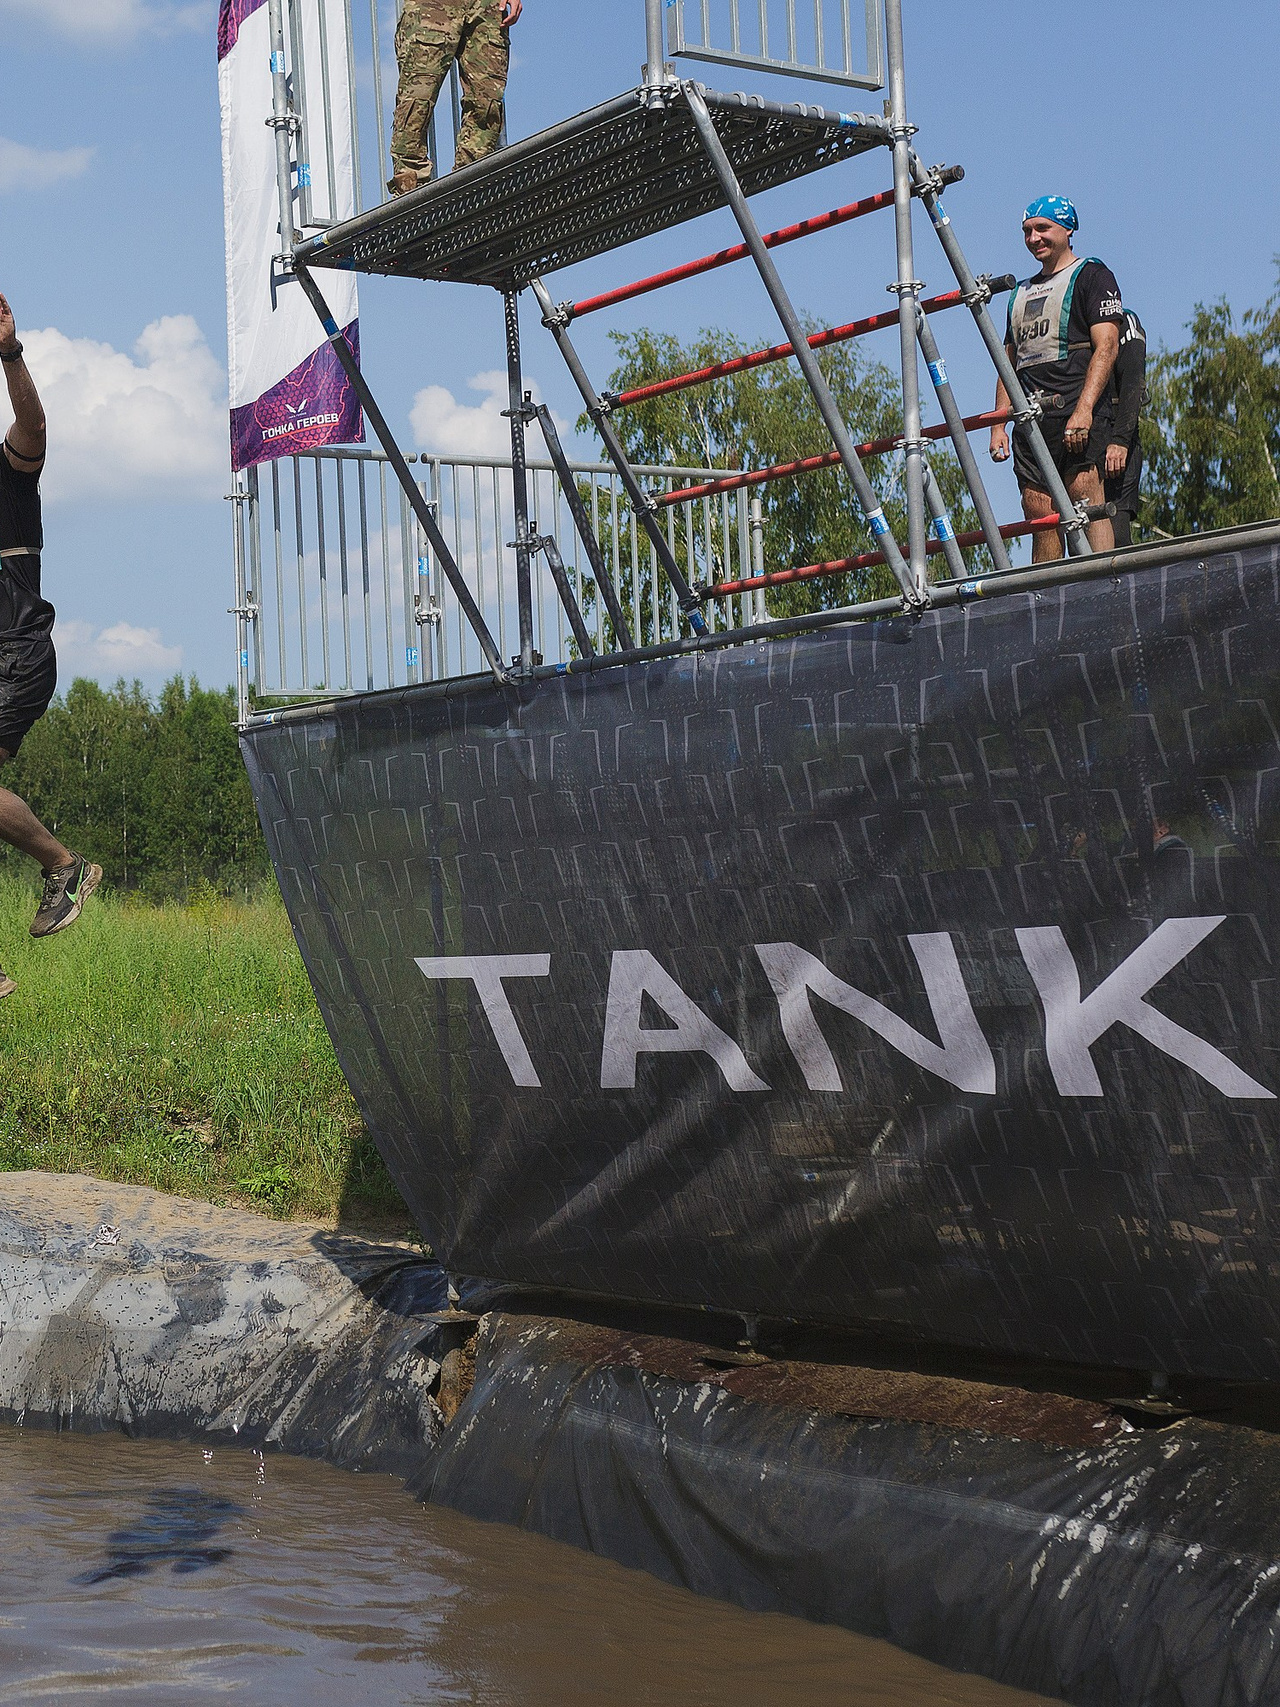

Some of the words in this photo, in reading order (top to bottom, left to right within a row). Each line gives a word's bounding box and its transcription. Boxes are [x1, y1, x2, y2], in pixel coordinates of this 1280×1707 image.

[262, 422, 294, 439] ГОНКА
[297, 413, 338, 429] ГЕРОЕВ
[413, 914, 1278, 1100] TANK
